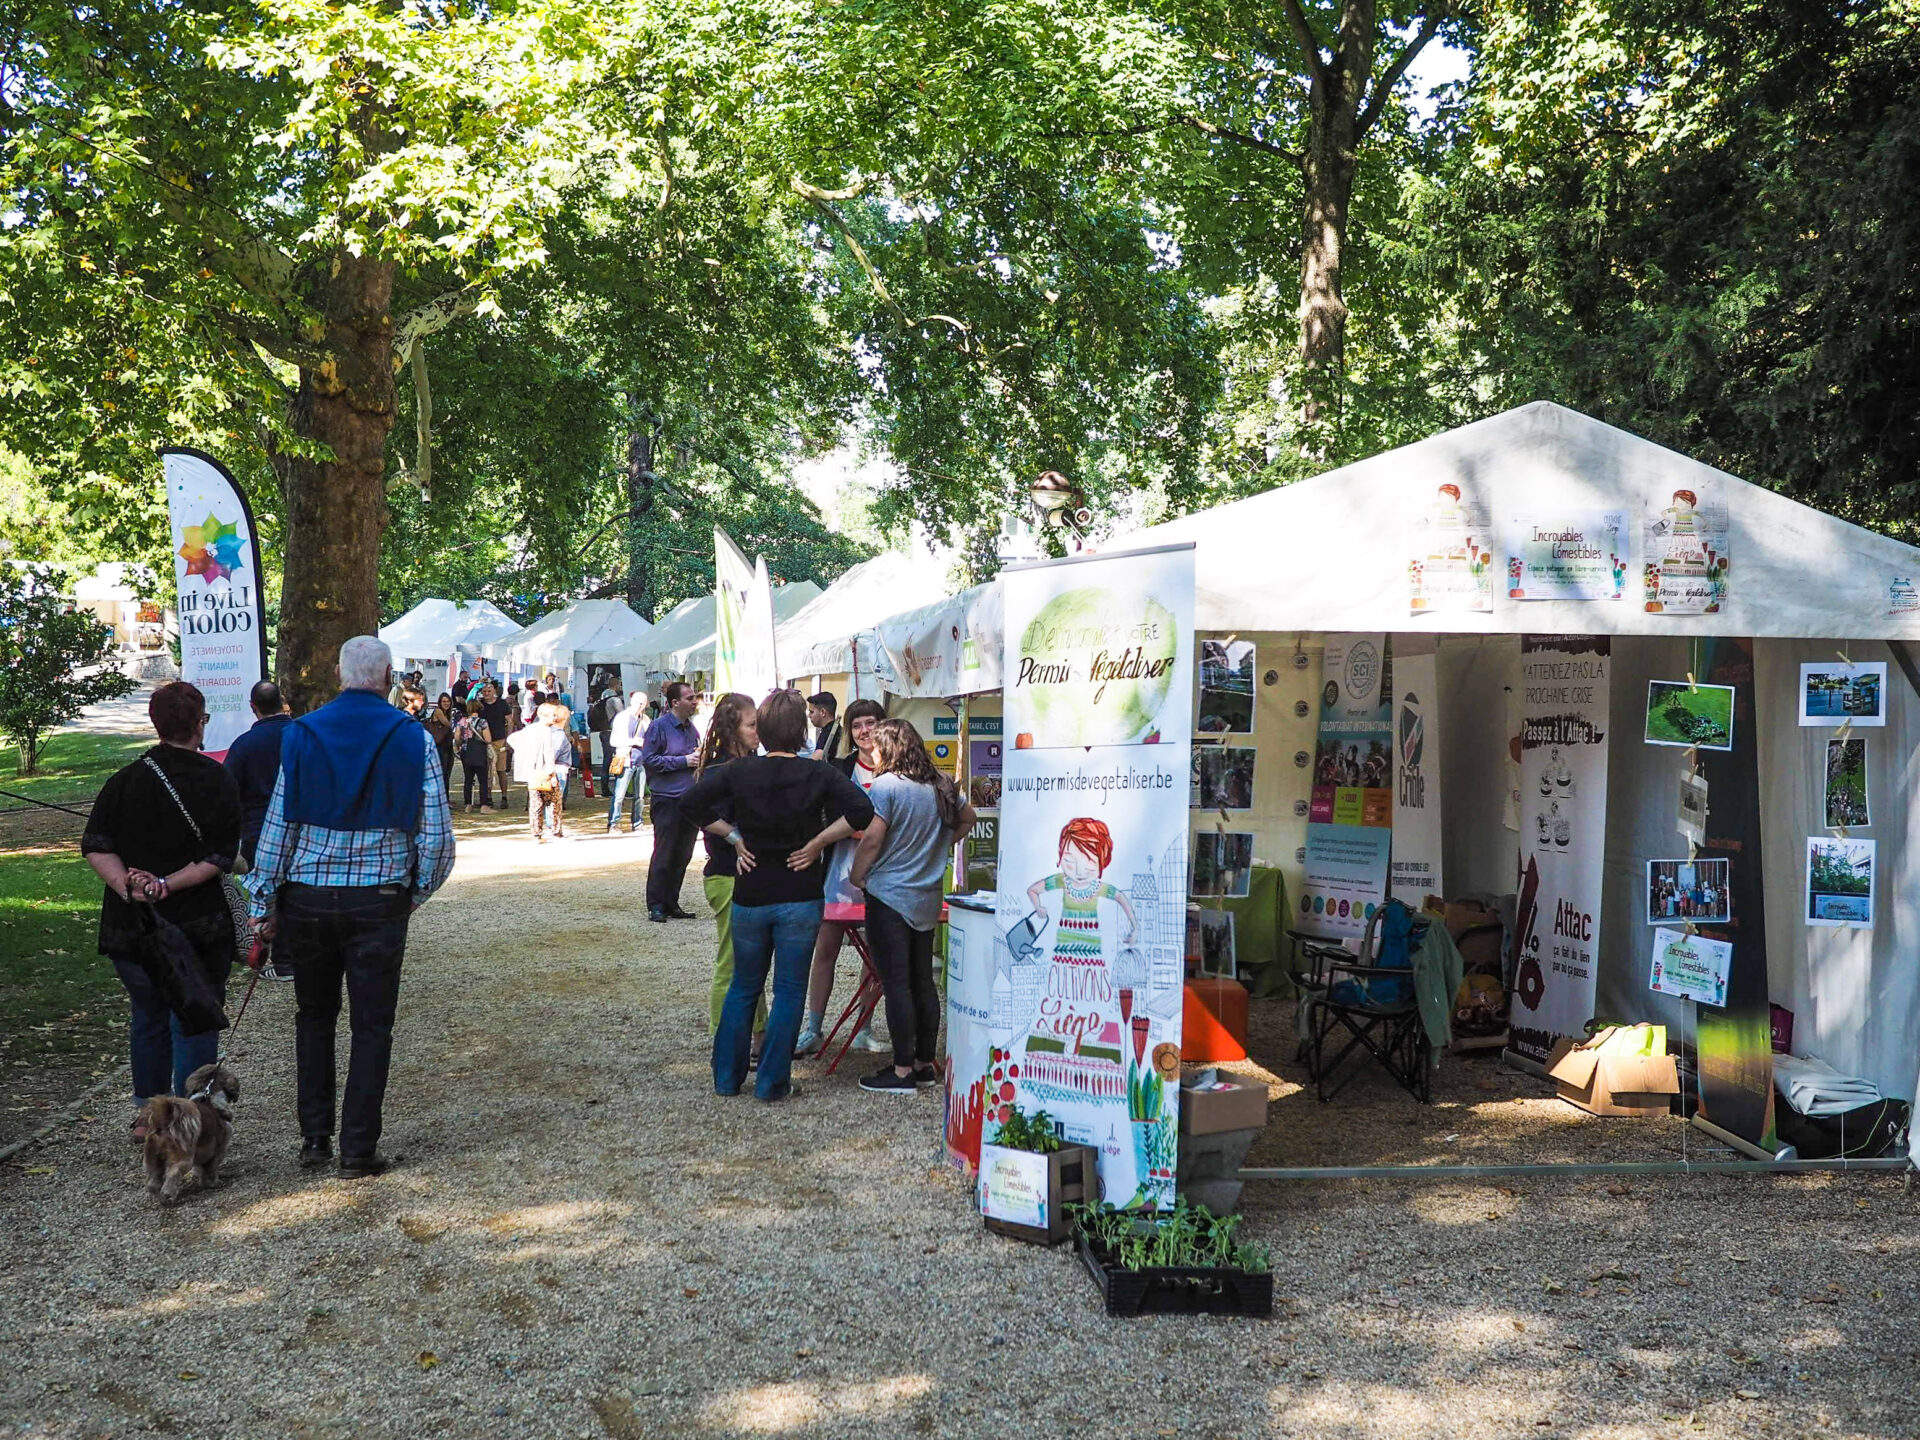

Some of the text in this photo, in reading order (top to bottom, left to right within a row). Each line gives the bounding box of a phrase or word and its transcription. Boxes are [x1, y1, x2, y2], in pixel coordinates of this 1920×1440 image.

[1532, 526, 1583, 548] Incroyables
[1552, 543, 1602, 559] Comestibles
[1126, 623, 1159, 641] OTRE
[1016, 646, 1175, 705] Permis Végétaliser
[1353, 663, 1370, 677] SCI
[1572, 661, 1588, 679] PAS
[1589, 661, 1605, 679] LA
[1525, 686, 1593, 704] PROCHAINE CRISE
[938, 721, 949, 730] ÊTRE
[985, 722, 999, 730] C'EST
[1523, 720, 1552, 741] Passez
[1553, 720, 1560, 741] à
[1561, 720, 1588, 742] l'Attac
[1008, 765, 1173, 805] www.permisdevegetaliser.be
[1554, 898, 1592, 942] Attac
[1668, 943, 1699, 961] Incroyables
[1678, 957, 1709, 975] Comestibles
[1048, 964, 1111, 1003] CULTIVONS
[1037, 997, 1104, 1054] Liège
[1102, 1143, 1121, 1156] Liège
[994, 1161, 1022, 1178] Incroyables
